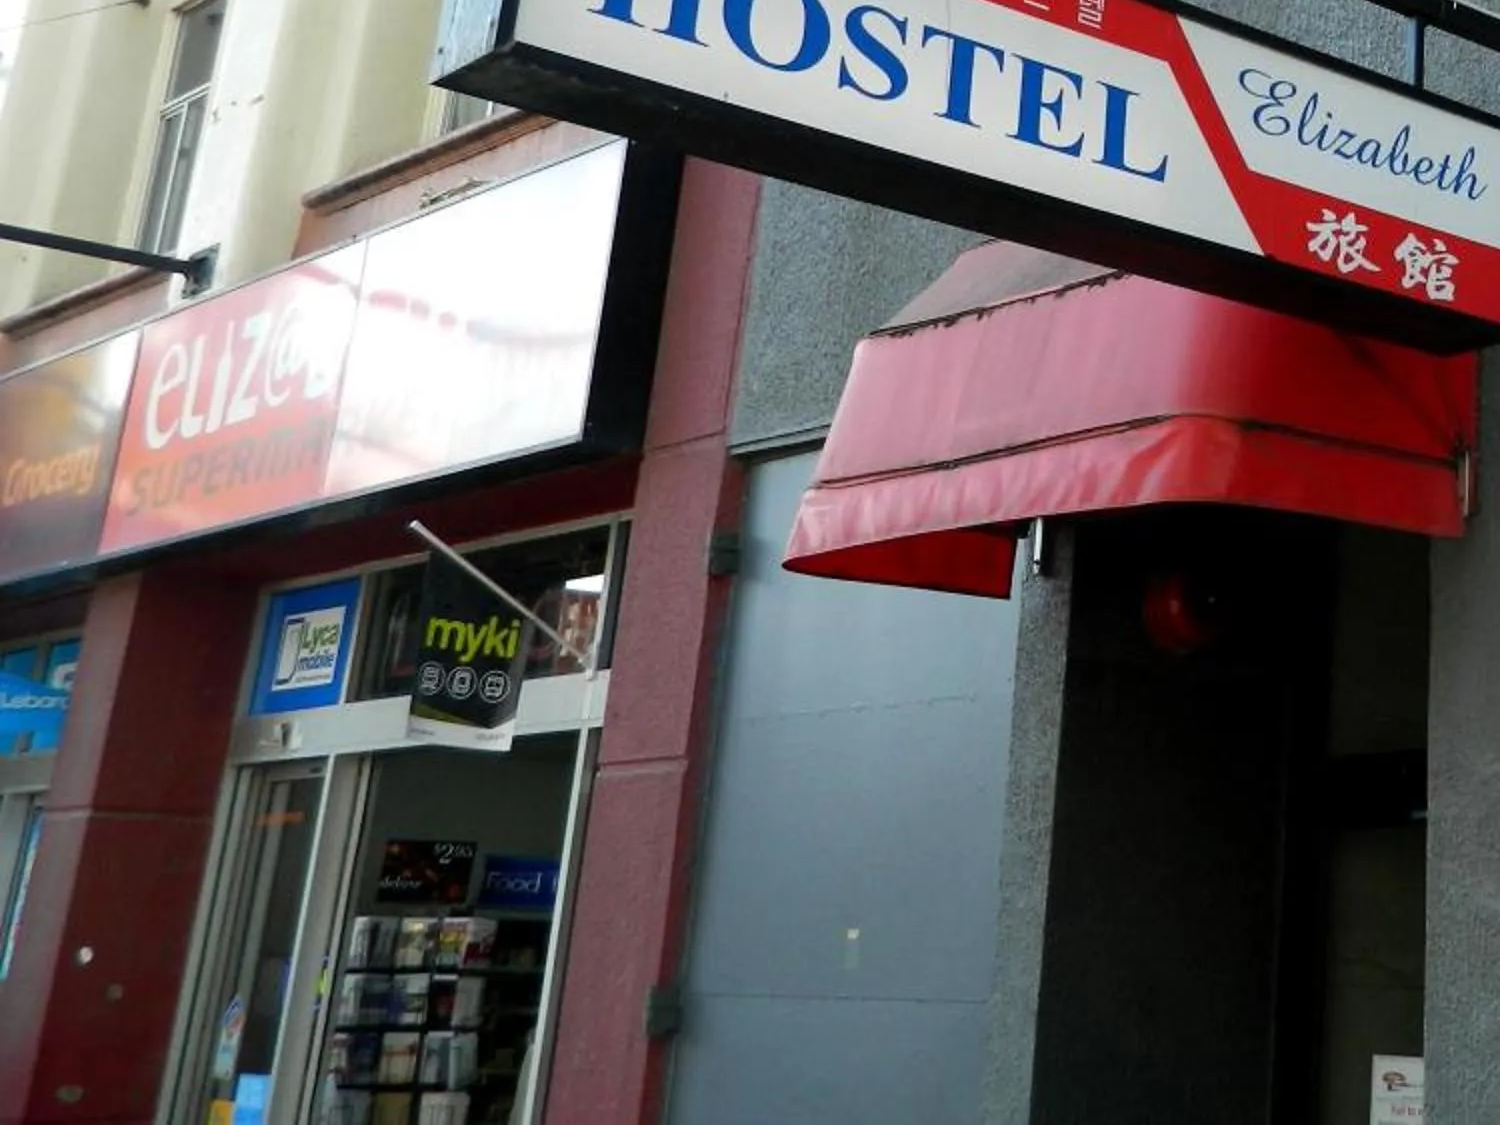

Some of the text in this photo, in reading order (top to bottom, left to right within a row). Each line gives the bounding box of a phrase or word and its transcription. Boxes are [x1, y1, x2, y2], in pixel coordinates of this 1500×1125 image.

[1238, 68, 1489, 201] Elizabeth
[1305, 208, 1460, 302] 旅館
[297, 649, 336, 672] mobile
[300, 622, 340, 653] Lyca
[424, 614, 521, 663] myki
